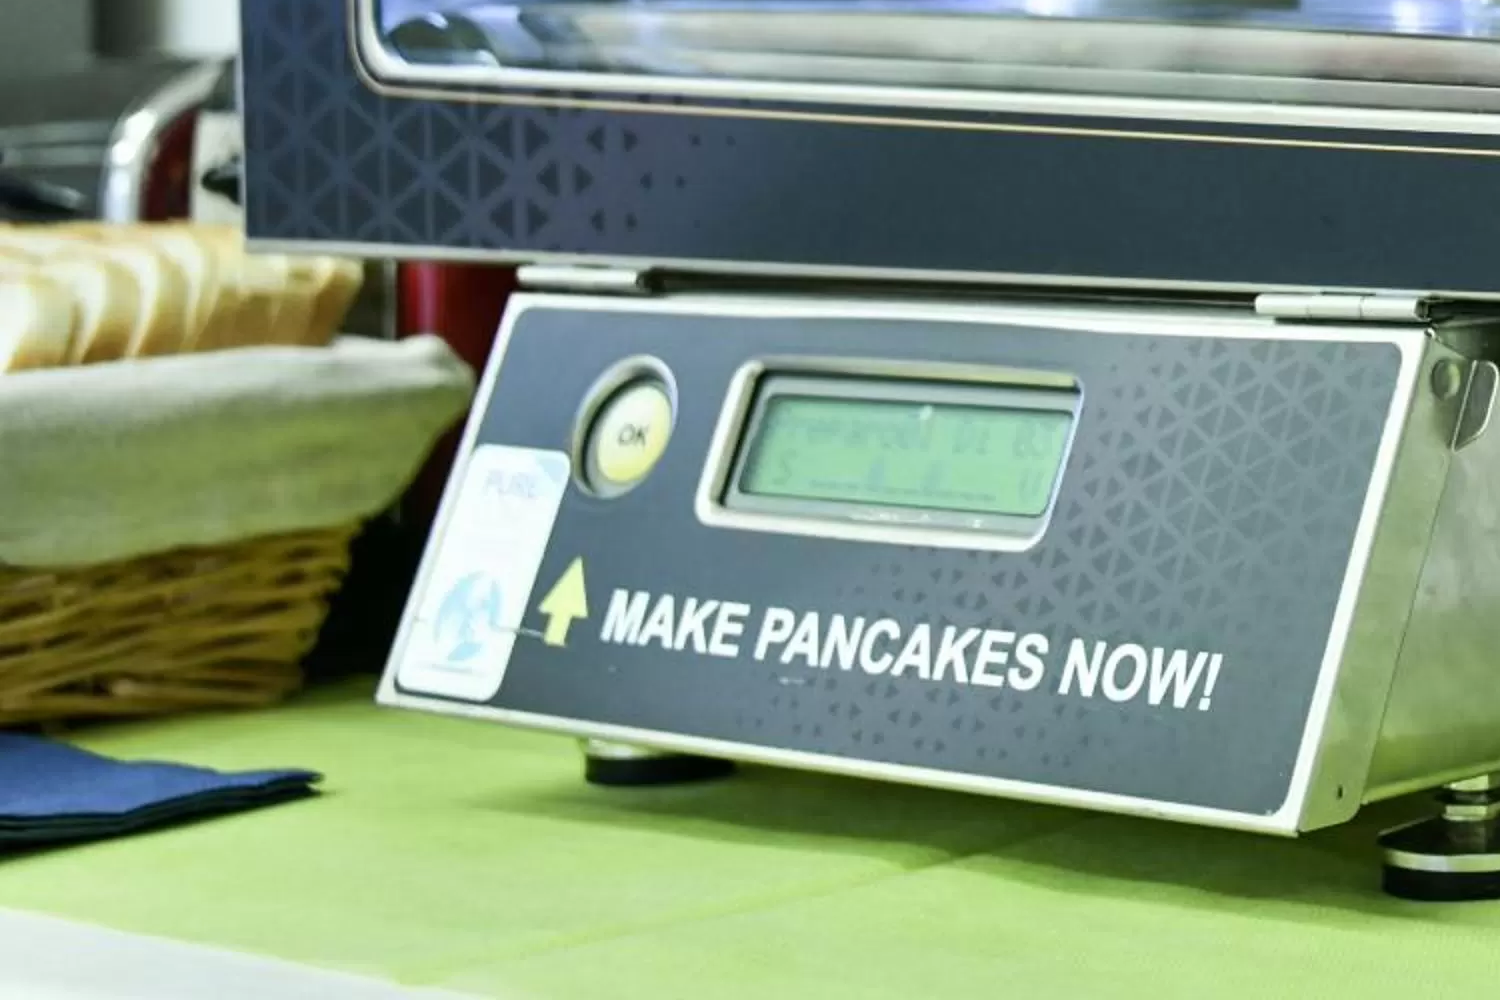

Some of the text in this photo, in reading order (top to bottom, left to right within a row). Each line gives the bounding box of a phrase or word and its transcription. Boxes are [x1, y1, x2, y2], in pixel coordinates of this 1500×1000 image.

[617, 423, 650, 449] OK
[600, 588, 1224, 711] MAKE PANCAKES NOW!
